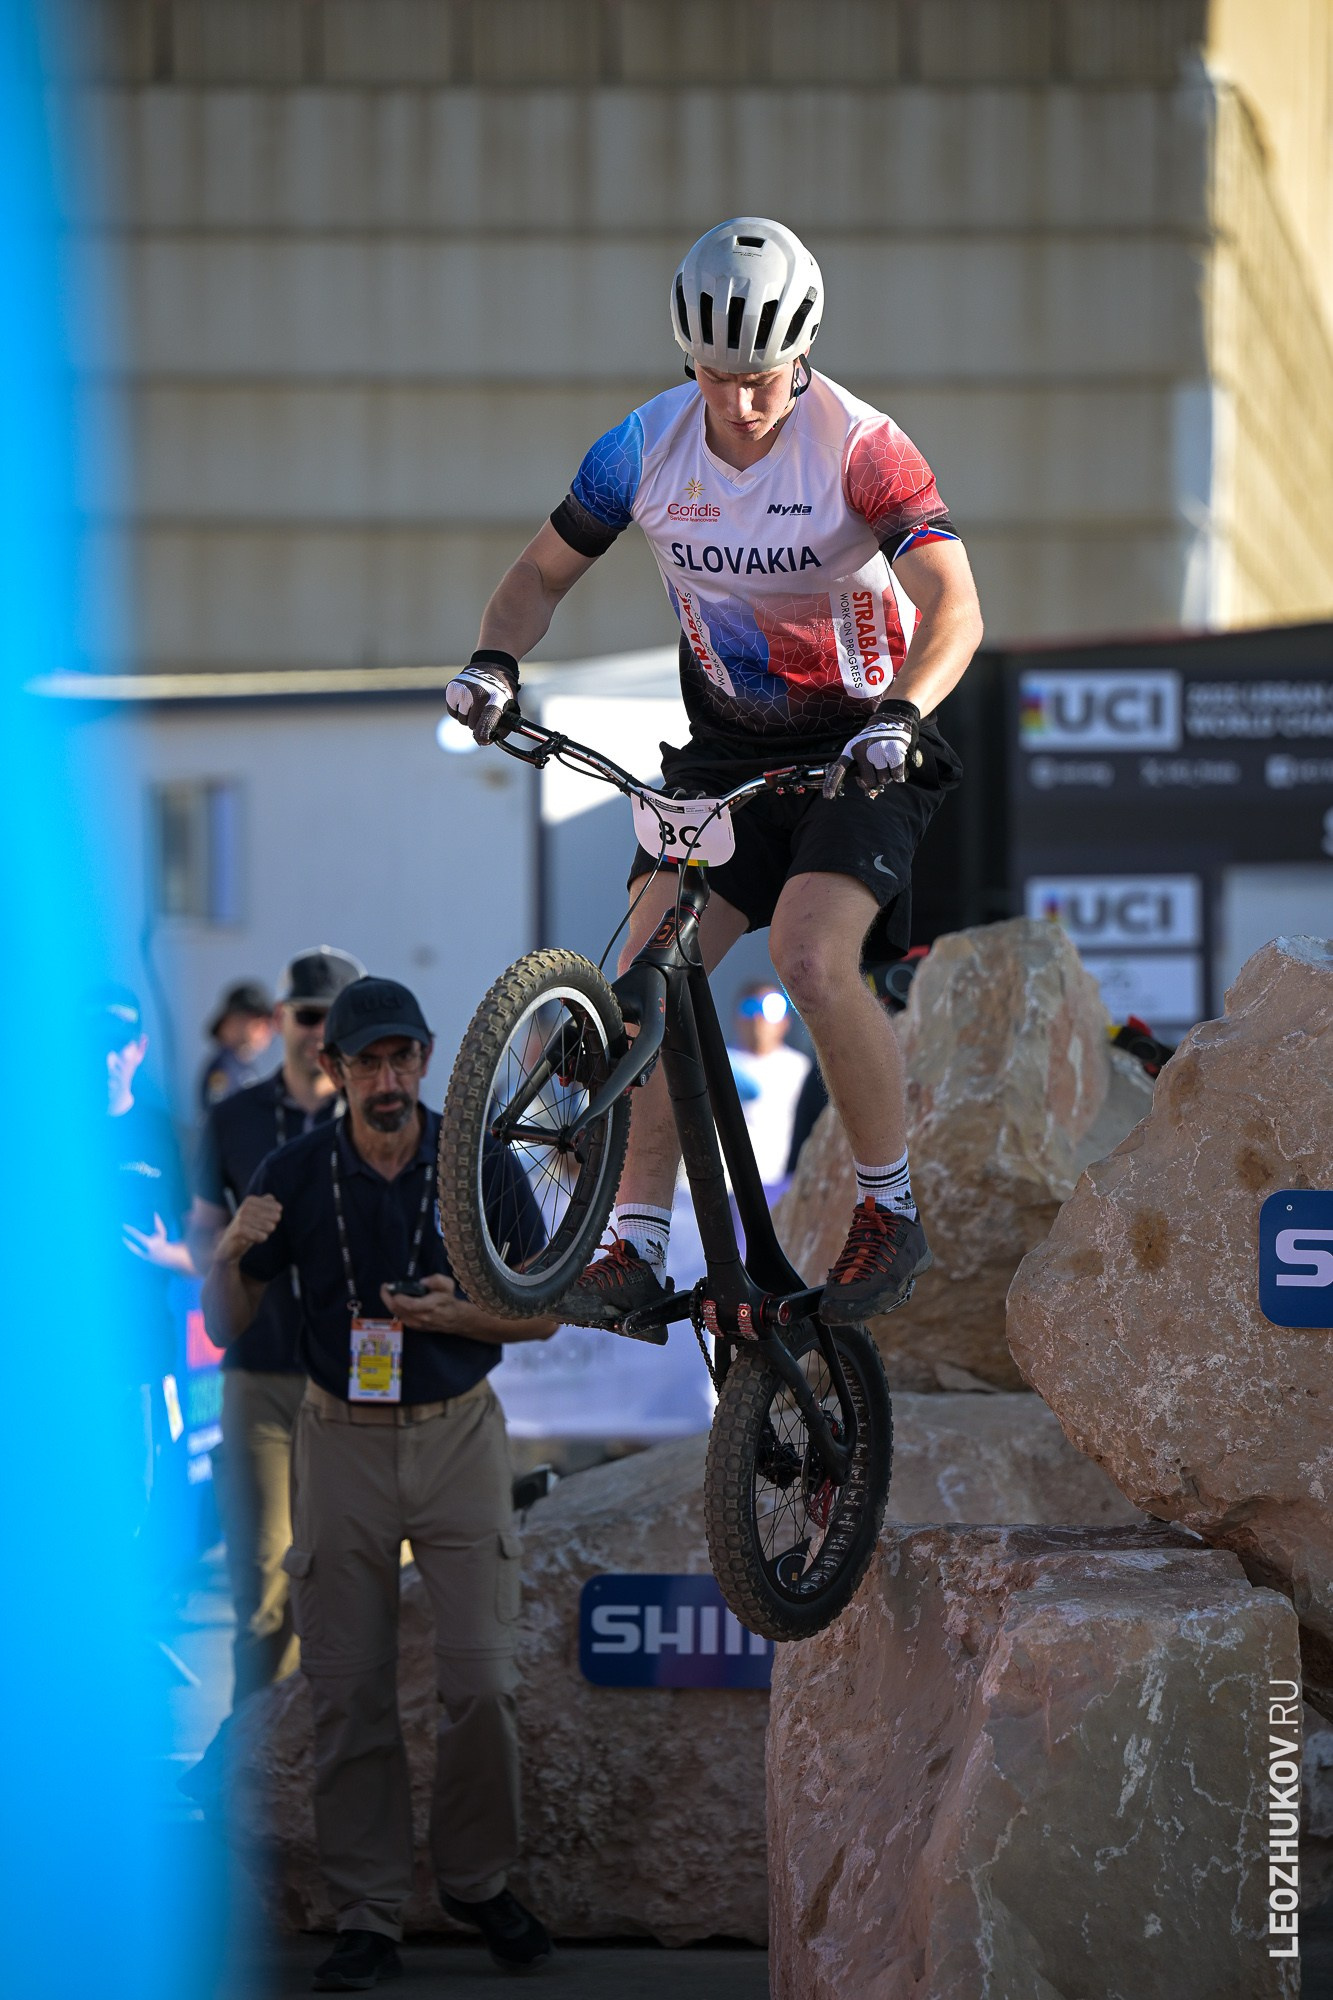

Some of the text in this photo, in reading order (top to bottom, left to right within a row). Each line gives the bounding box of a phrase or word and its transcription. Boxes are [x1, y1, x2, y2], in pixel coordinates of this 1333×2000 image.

[667, 503, 721, 517] Cofidis
[766, 503, 813, 516] NyNa
[671, 542, 822, 574] SLOVAKIA
[840, 592, 863, 689] WORK ON PROGRESS
[852, 591, 885, 686] STRABAG
[712, 658, 726, 686] WORK
[1054, 687, 1164, 734] UCI
[1069, 892, 1172, 933] UCI
